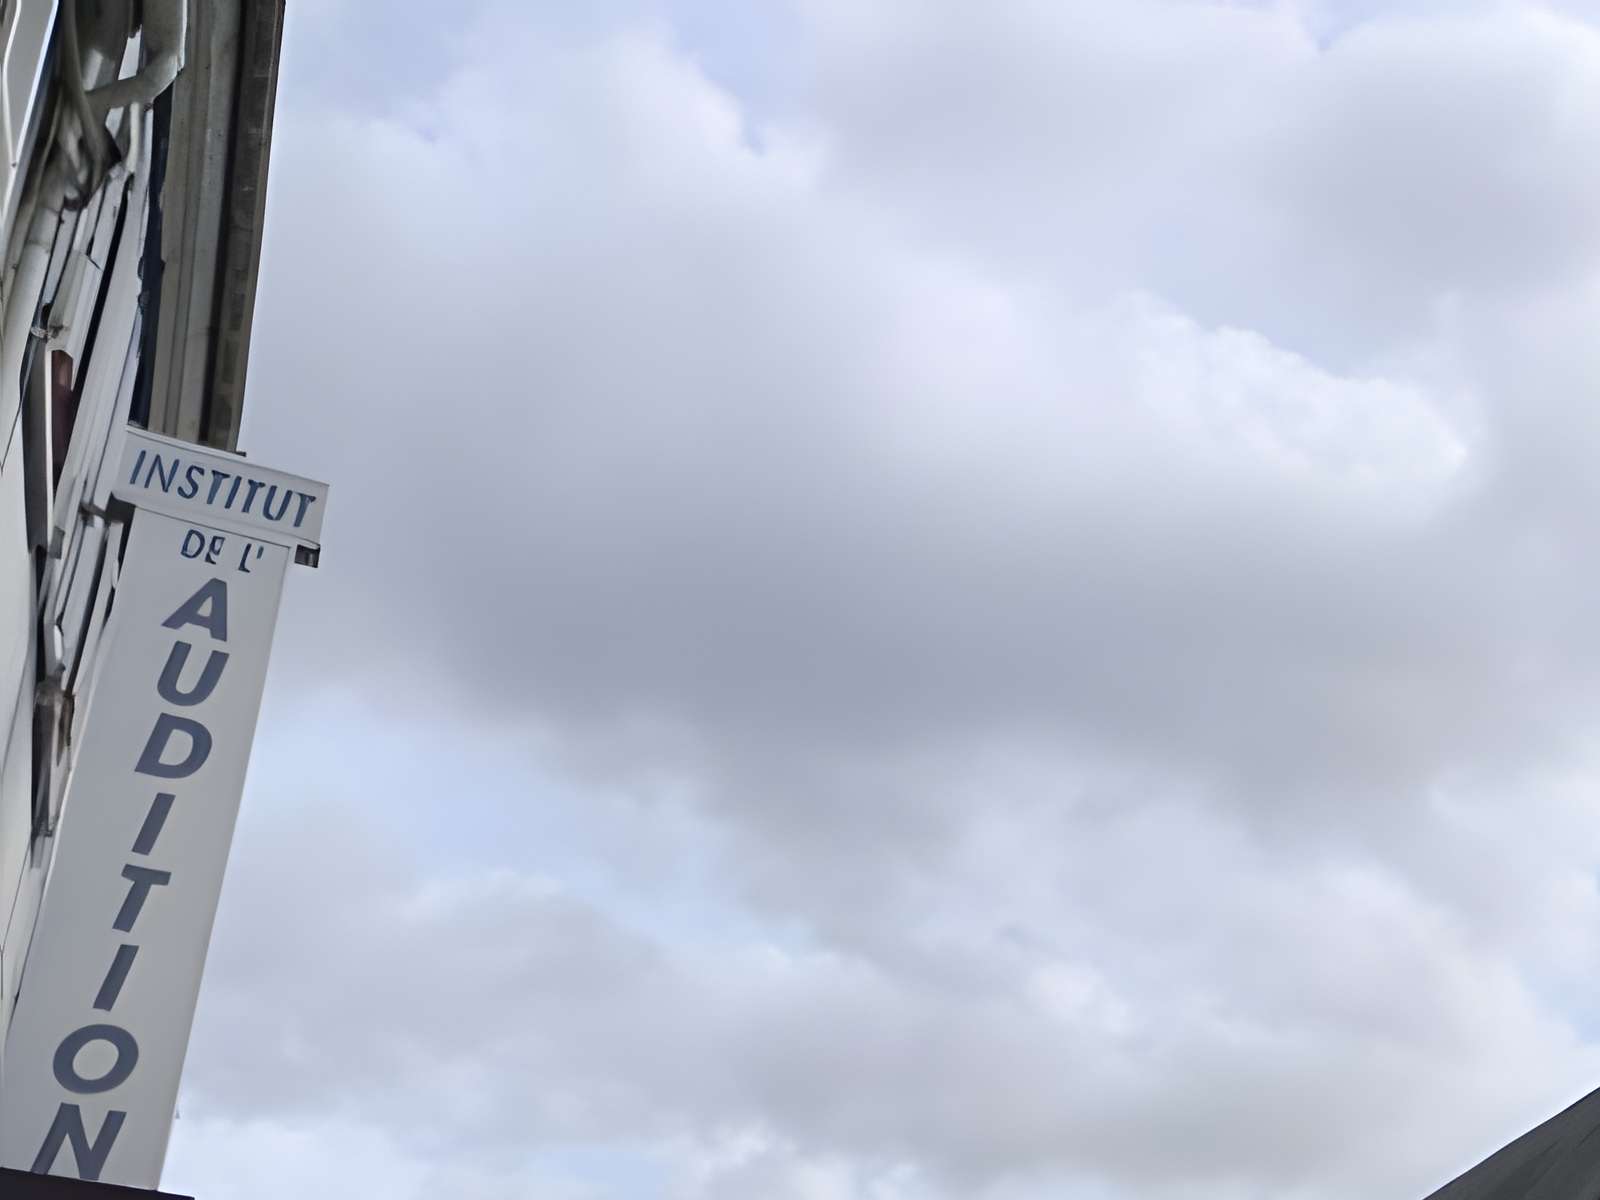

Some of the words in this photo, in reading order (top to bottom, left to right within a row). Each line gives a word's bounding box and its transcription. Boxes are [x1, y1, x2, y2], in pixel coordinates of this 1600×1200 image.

[129, 450, 317, 528] INSTITUT
[180, 529, 226, 565] DE
[238, 543, 265, 573] L'
[29, 577, 230, 1181] AUDITION
